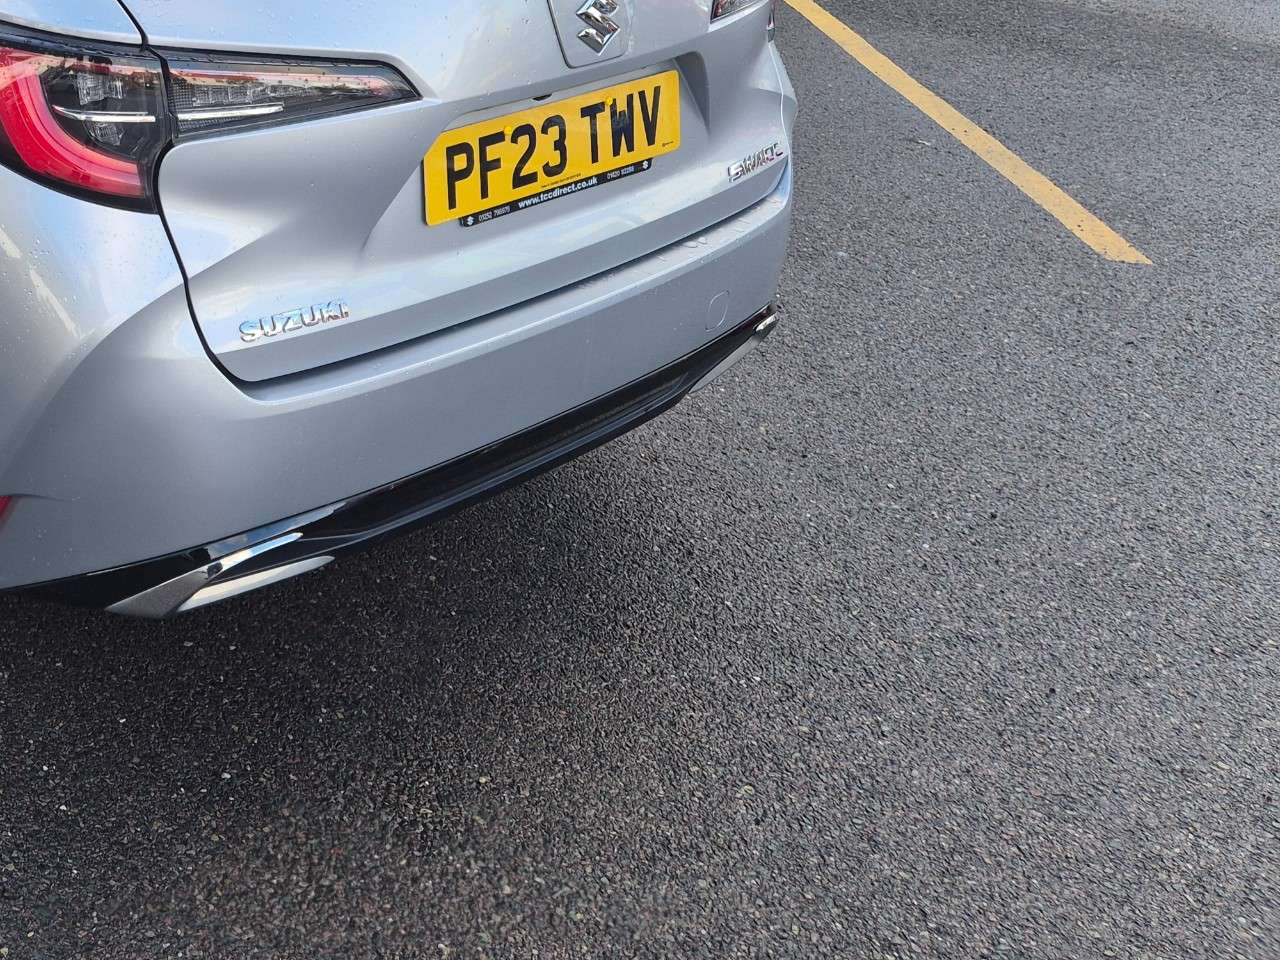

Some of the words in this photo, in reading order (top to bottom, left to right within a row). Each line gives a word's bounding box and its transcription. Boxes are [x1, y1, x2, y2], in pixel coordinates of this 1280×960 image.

[445, 114, 568, 211] PF23
[580, 85, 661, 165] TWV
[239, 301, 350, 343] SUZUKI
